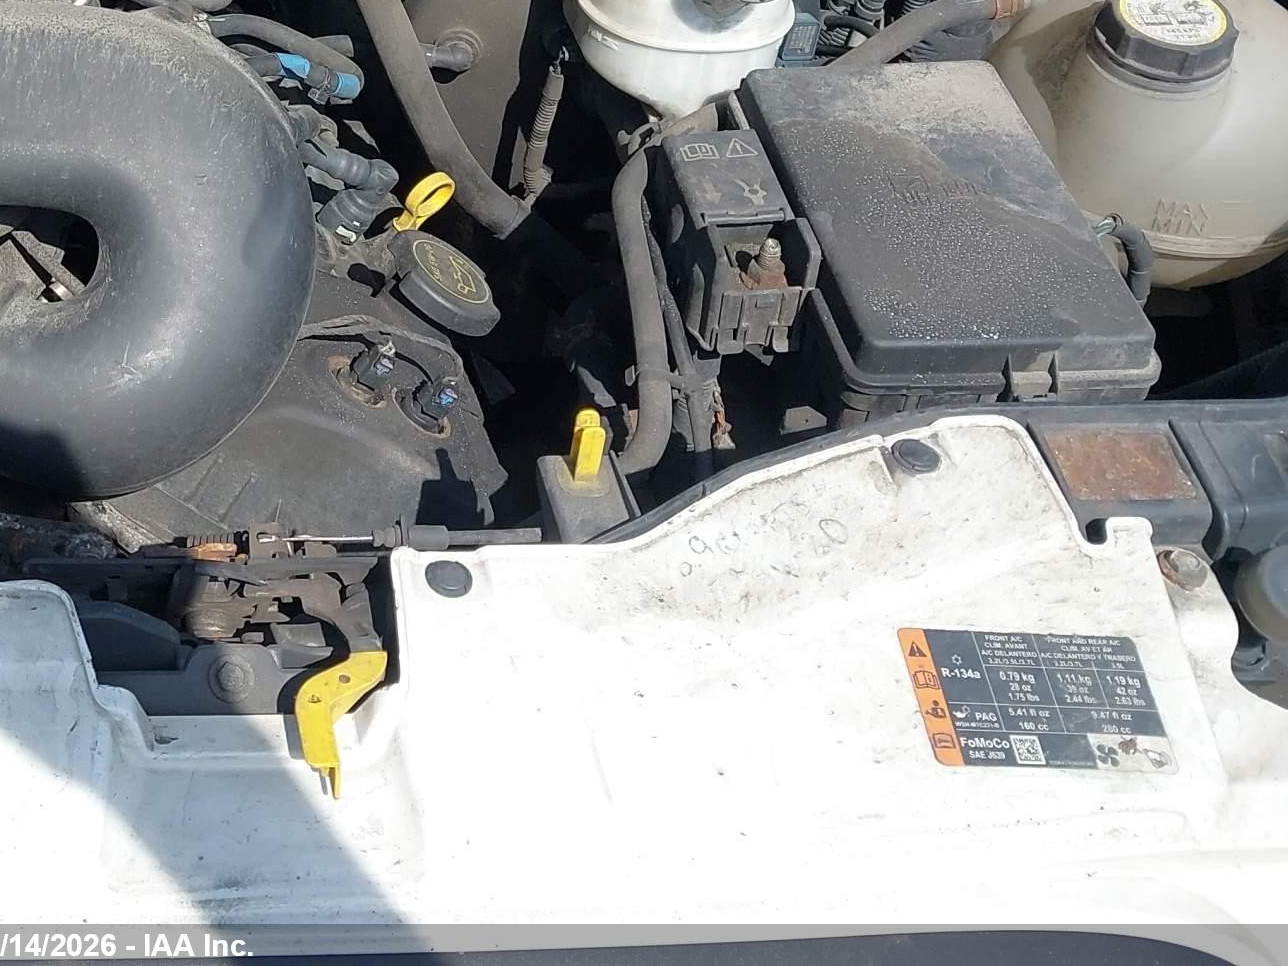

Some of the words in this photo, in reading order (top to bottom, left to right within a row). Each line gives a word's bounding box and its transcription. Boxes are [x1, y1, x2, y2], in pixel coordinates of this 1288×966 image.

[994, 650, 1037, 658] DELANTERO
[1054, 652, 1096, 660] DELANTERO
[1104, 654, 1136, 662] TRASERO
[940, 668, 982, 679] R-134a
[998, 670, 1020, 682] 0.79
[1022, 672, 1036, 684] kg
[1056, 673, 1074, 684] 1.11
[1078, 674, 1092, 686] kg
[1106, 675, 1126, 686] 1.19
[1128, 676, 1141, 689] kg
[1008, 682, 1020, 691] 28
[1116, 686, 1126, 696] 42
[1008, 692, 1026, 702] 1.75
[1026, 693, 1040, 702] lbs
[1084, 695, 1096, 704] lbs
[1134, 698, 1146, 706] lbs
[974, 712, 998, 722] PAG
[1008, 707, 1028, 716] 5.41
[1028, 708, 1037, 717] fl
[1112, 712, 1120, 720] fl
[1018, 722, 1036, 730] 160
[960, 736, 1010, 749] FoMoCo
[969, 750, 986, 760] SAE
[988, 750, 1006, 760] J639
